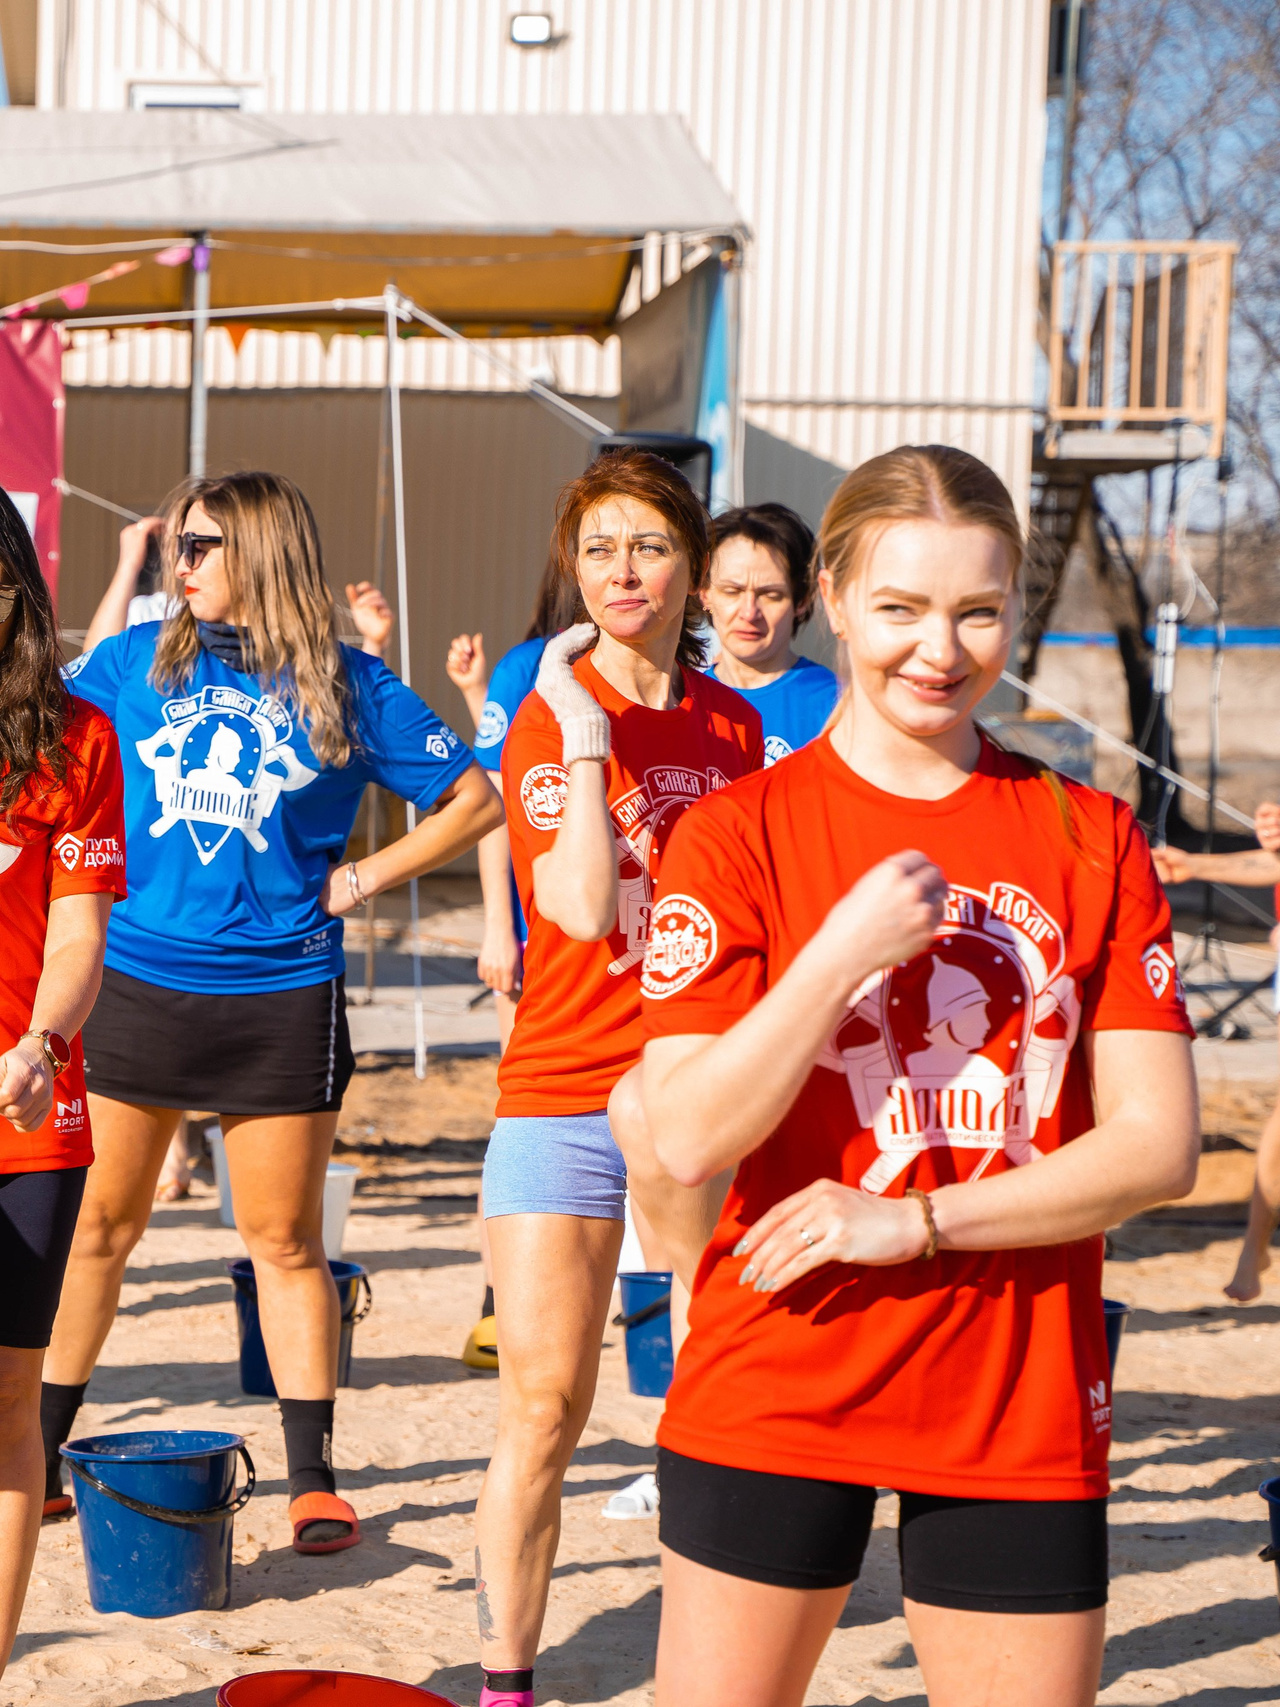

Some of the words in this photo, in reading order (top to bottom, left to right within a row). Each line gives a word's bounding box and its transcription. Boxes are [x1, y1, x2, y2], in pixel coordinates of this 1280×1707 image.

[170, 781, 258, 820] ЯРОПОЛК
[616, 792, 651, 828] СИЛА
[653, 771, 702, 796] СЛАВА
[85, 838, 119, 851] ПУТЬ
[994, 887, 1055, 943] ДОЛГ
[302, 938, 332, 955] SPORT
[54, 1115, 85, 1128] SPORT
